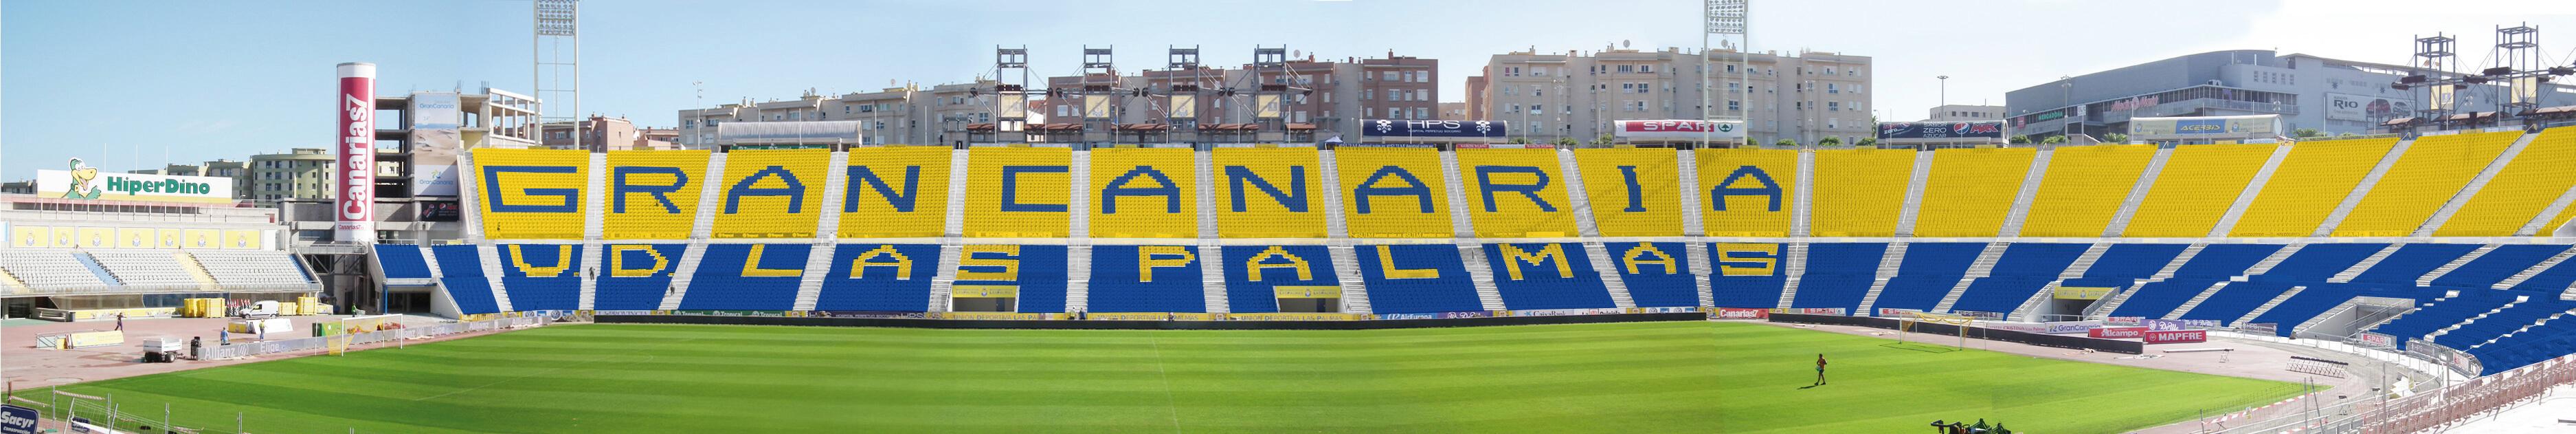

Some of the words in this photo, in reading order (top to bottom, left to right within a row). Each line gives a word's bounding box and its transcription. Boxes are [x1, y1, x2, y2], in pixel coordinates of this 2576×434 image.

[2334, 100, 2358, 109] RIO
[1407, 120, 1461, 129] HPS
[1644, 121, 1712, 131] SPAR
[344, 94, 368, 220] Canarias7
[108, 176, 210, 195] HiperDino
[483, 165, 920, 214] GRAN
[1001, 165, 1782, 214] CANARIA
[740, 243, 1020, 281] LAS
[1139, 242, 1779, 282] PALMAS
[1720, 310, 1758, 318] Canarias7
[2101, 329, 2138, 338] Alcampo
[2158, 332, 2202, 341] MAPFRE
[204, 346, 236, 360] Allianz
[1, 411, 34, 428] Sacyr
